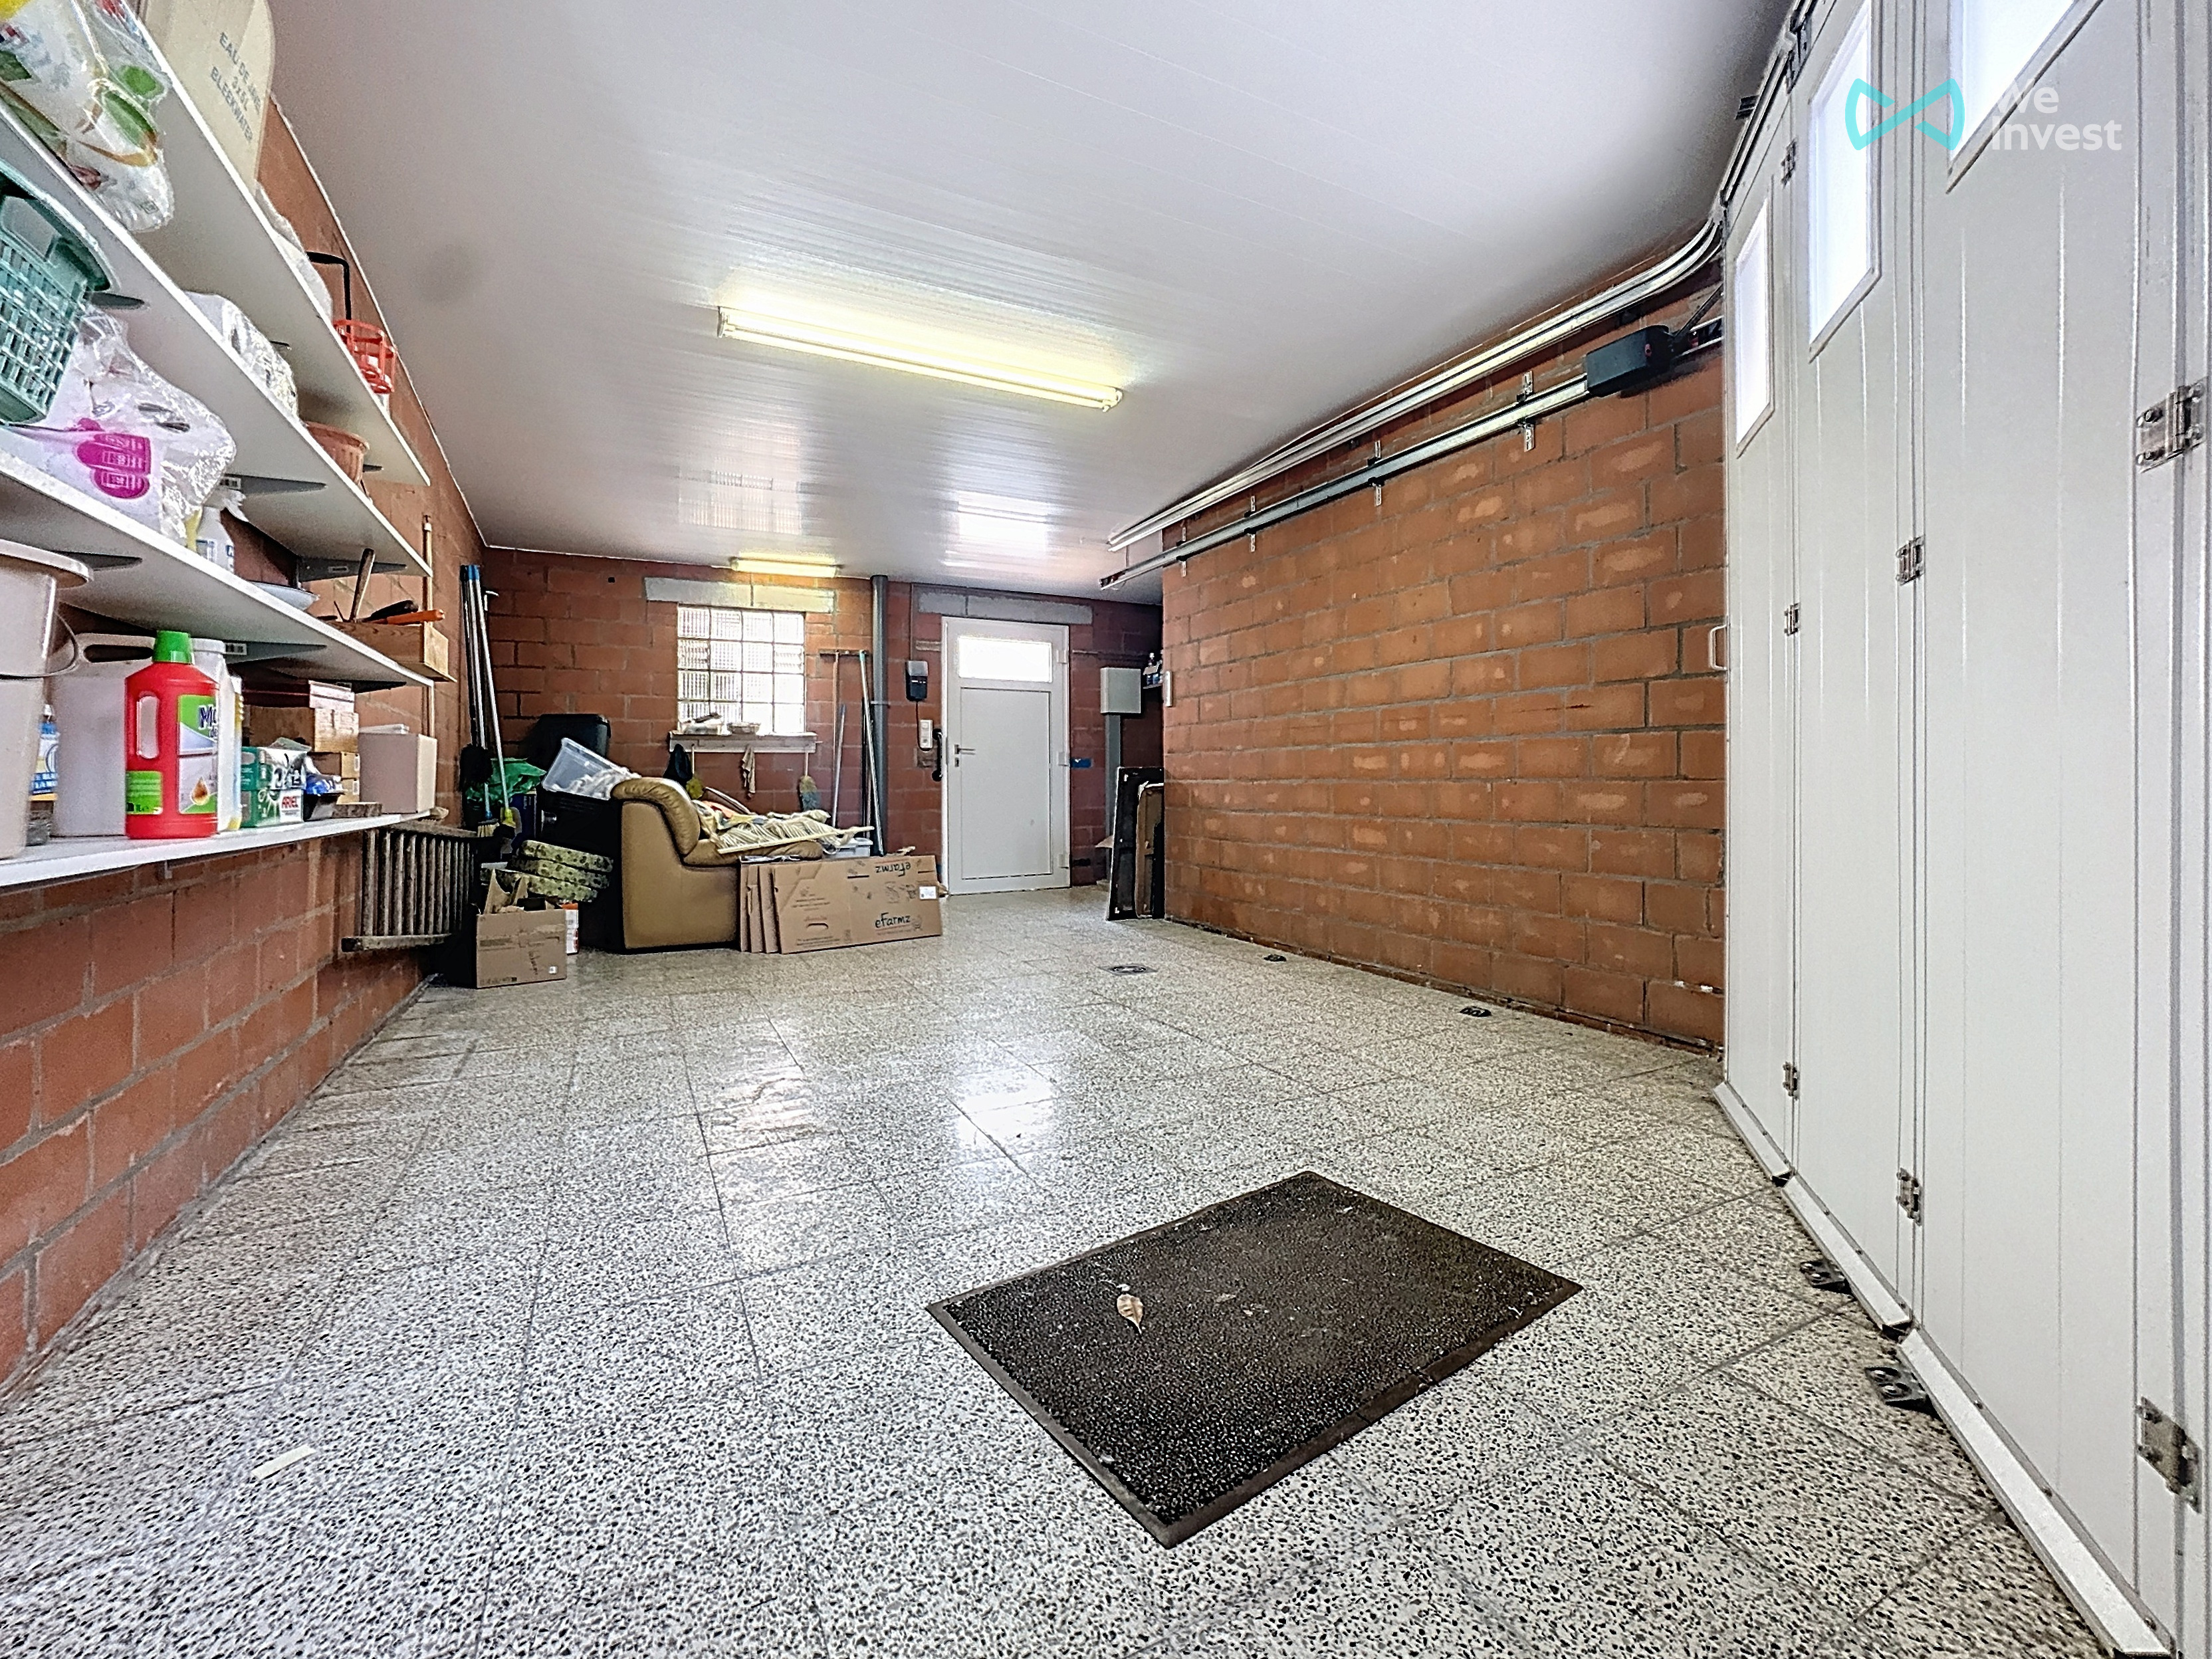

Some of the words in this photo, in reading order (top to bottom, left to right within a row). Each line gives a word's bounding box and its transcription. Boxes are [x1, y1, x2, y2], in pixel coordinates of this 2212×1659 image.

[219, 32, 239, 65] EAU
[239, 62, 250, 84] DE
[875, 912, 911, 929] eFarmz
